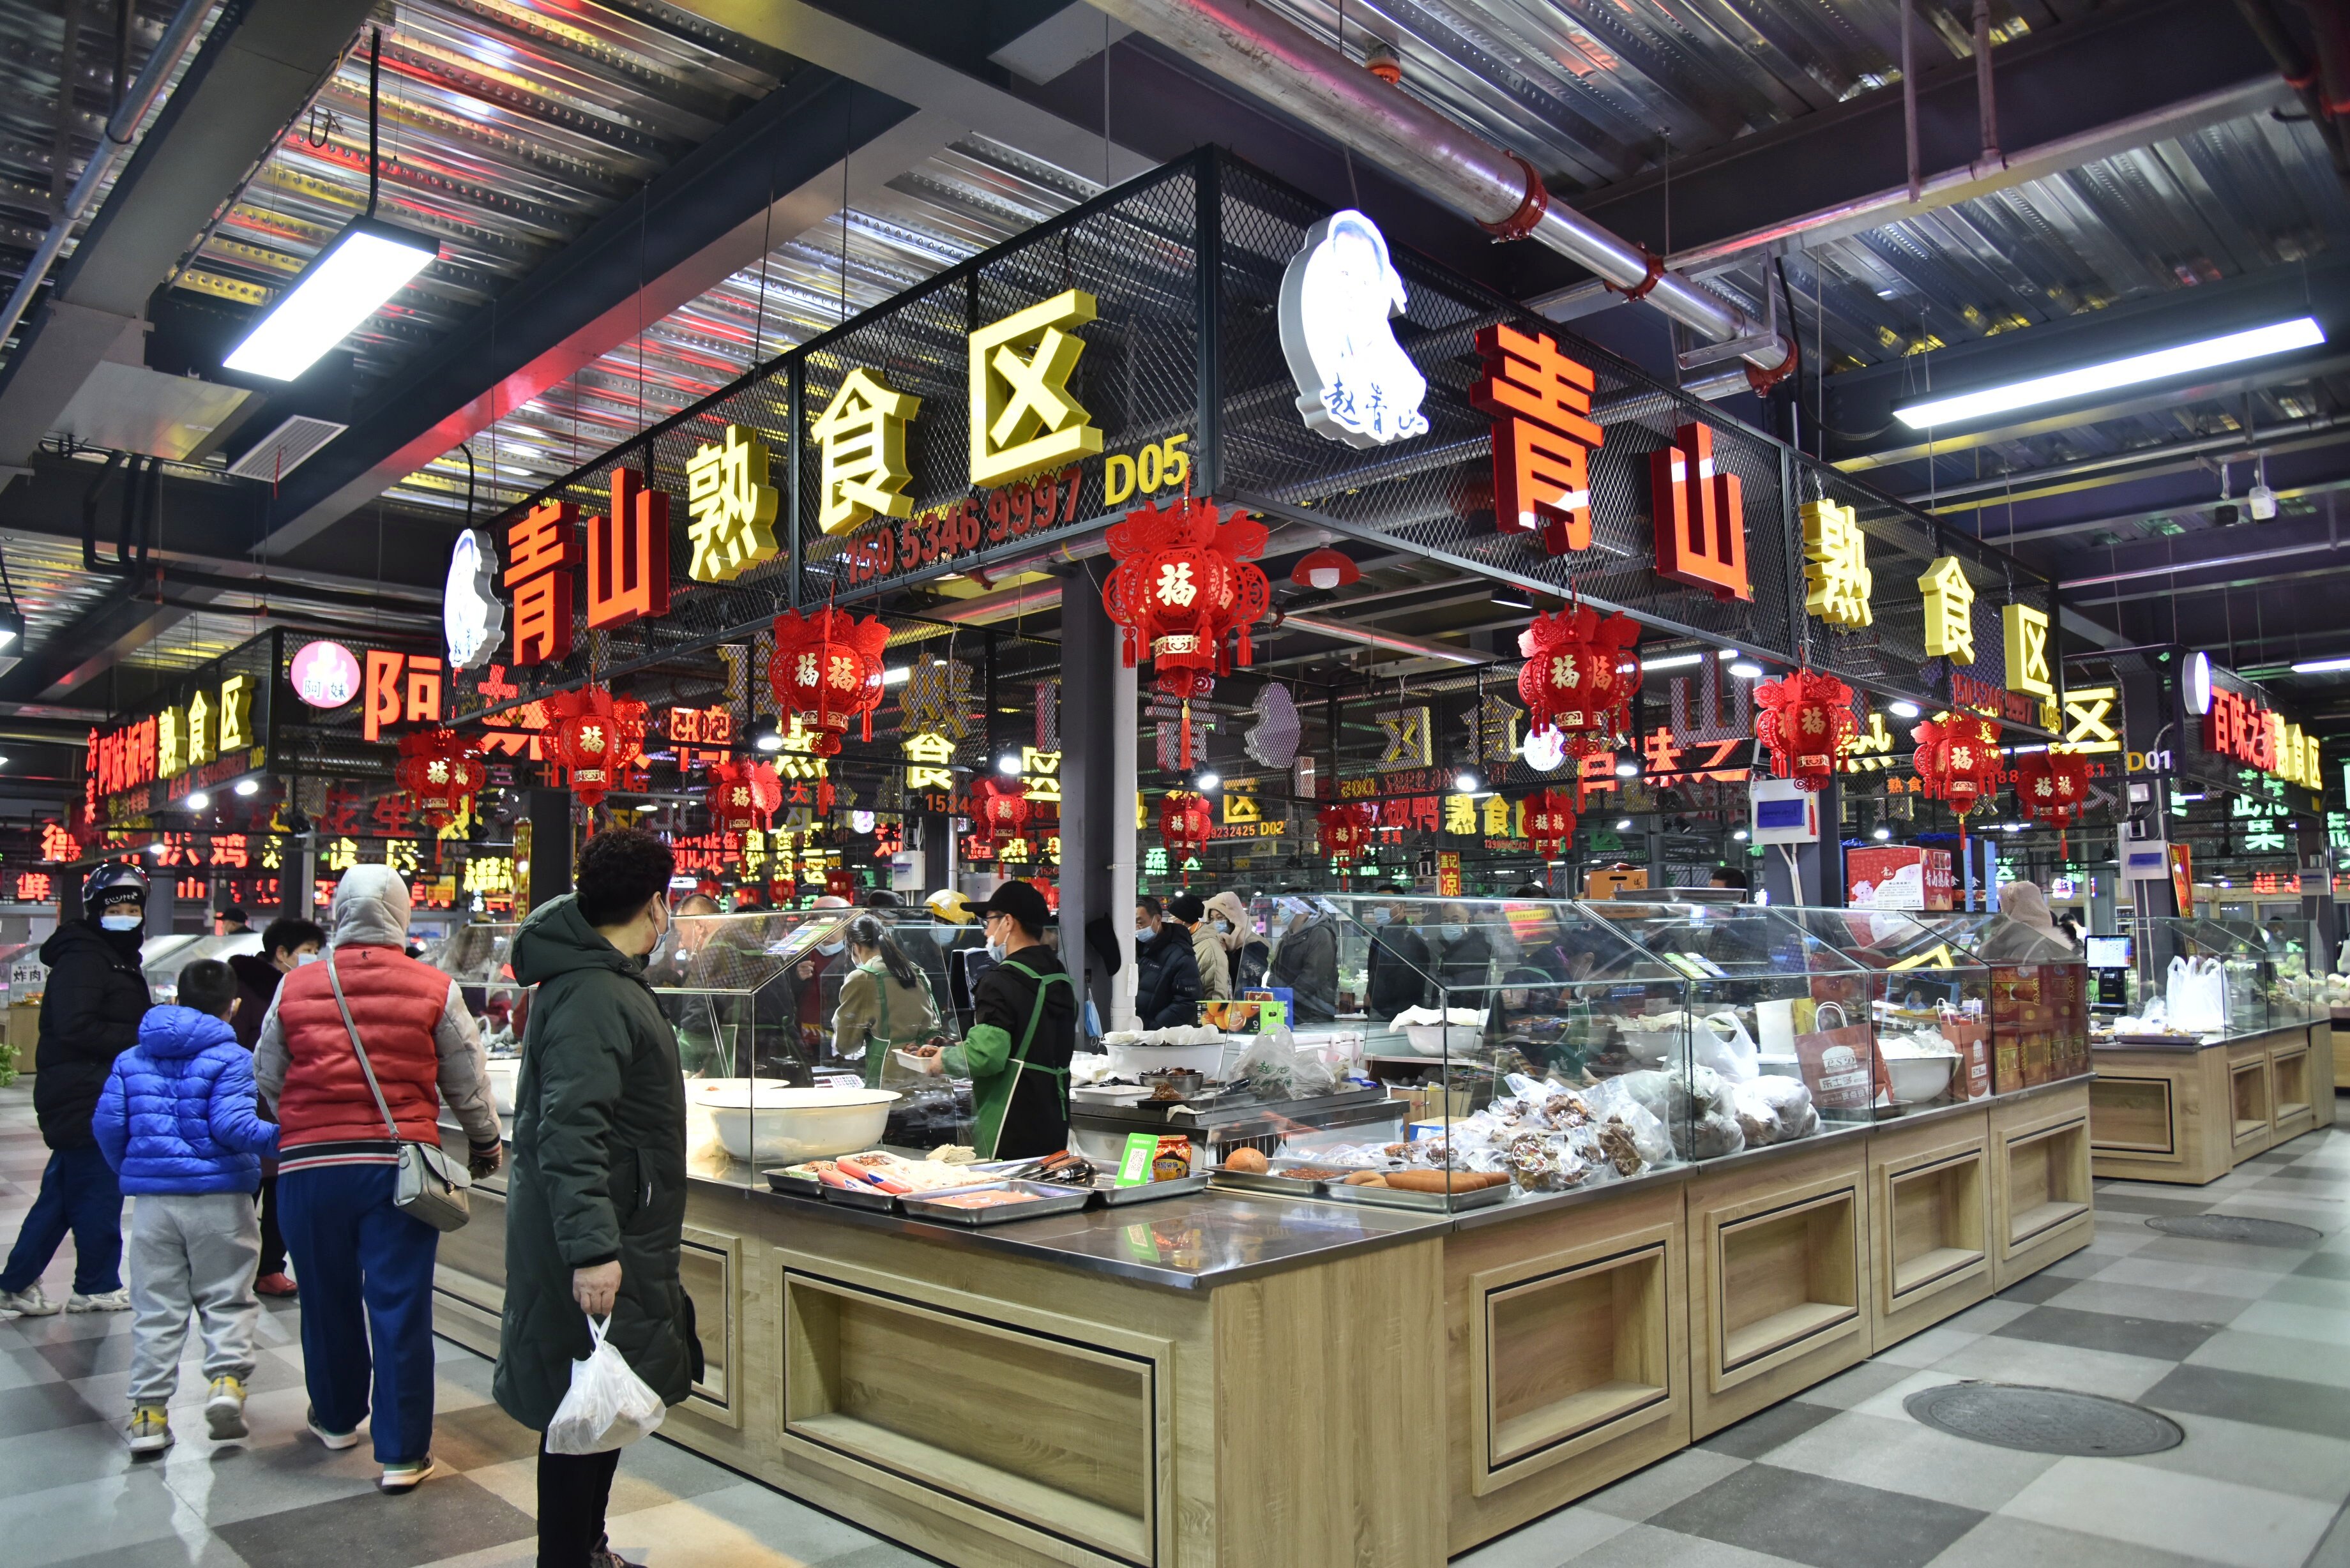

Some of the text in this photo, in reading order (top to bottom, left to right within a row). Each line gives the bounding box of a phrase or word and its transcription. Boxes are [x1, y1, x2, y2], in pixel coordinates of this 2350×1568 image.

[1324, 372, 1424, 435] 赵青山
[504, 289, 1093, 666] 青山熟食区
[844, 433, 1188, 584] 150 5346 9997 D05
[1472, 324, 2052, 697] 青山熟食区
[1156, 562, 1197, 607] 福
[795, 652, 819, 687] 福
[827, 656, 857, 692] 福
[1550, 655, 1581, 689] 福
[305, 679, 346, 698] 阿妹
[1952, 674, 1973, 705] 150
[2039, 702, 2061, 730] D05
[1801, 707, 1826, 735] 福
[99, 675, 246, 796] 阿妹板鸭熟食区
[579, 726, 605, 753] 福
[2211, 685, 2322, 790] 百味之家熟食区
[1950, 746, 1973, 770] 福
[2128, 751, 2171, 771] D01
[427, 761, 450, 784] 福
[2058, 776, 2074, 796] 福
[732, 787, 750, 807] 福
[2035, 777, 2052, 797] 福
[997, 801, 1013, 819] 福
[1261, 821, 1284, 835] D02
[1336, 827, 1350, 842] 福
[827, 857, 840, 867] D03
[13, 970, 41, 982] 炸肉
